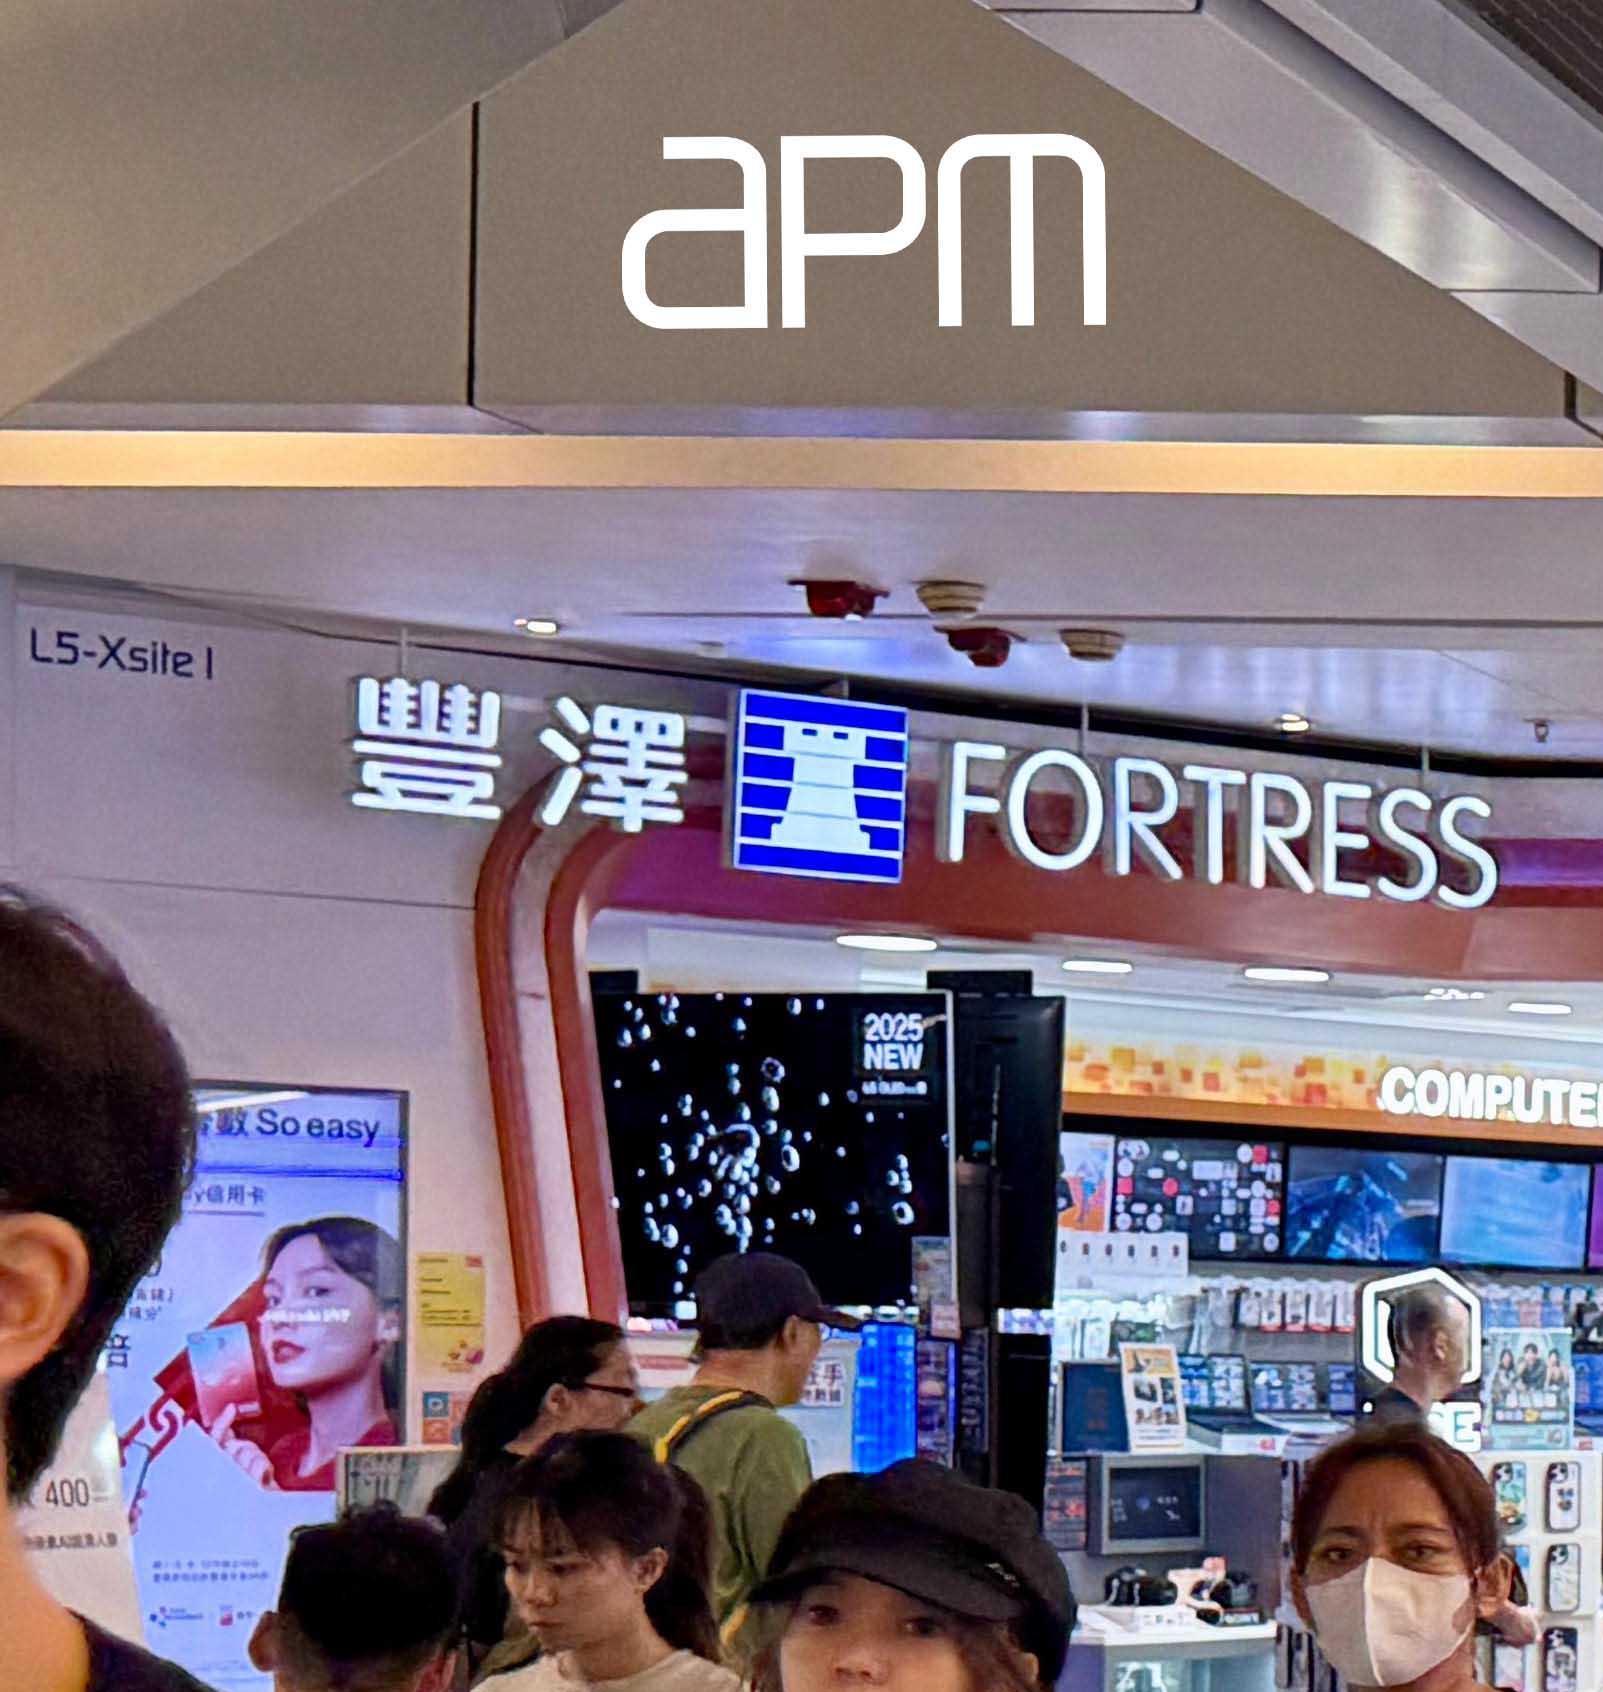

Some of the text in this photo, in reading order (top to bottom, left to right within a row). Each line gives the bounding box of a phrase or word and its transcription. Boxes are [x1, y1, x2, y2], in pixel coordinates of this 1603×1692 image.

[29, 627, 195, 678] L5-Xsite
[352, 677, 688, 833] 豐澤
[944, 740, 1497, 910] FORTRESS
[863, 1012, 924, 1041] 2025
[863, 1042, 924, 1070] NEW
[256, 1108, 300, 1137] So
[307, 1117, 380, 1148] easy
[45, 1477, 90, 1508] 400
